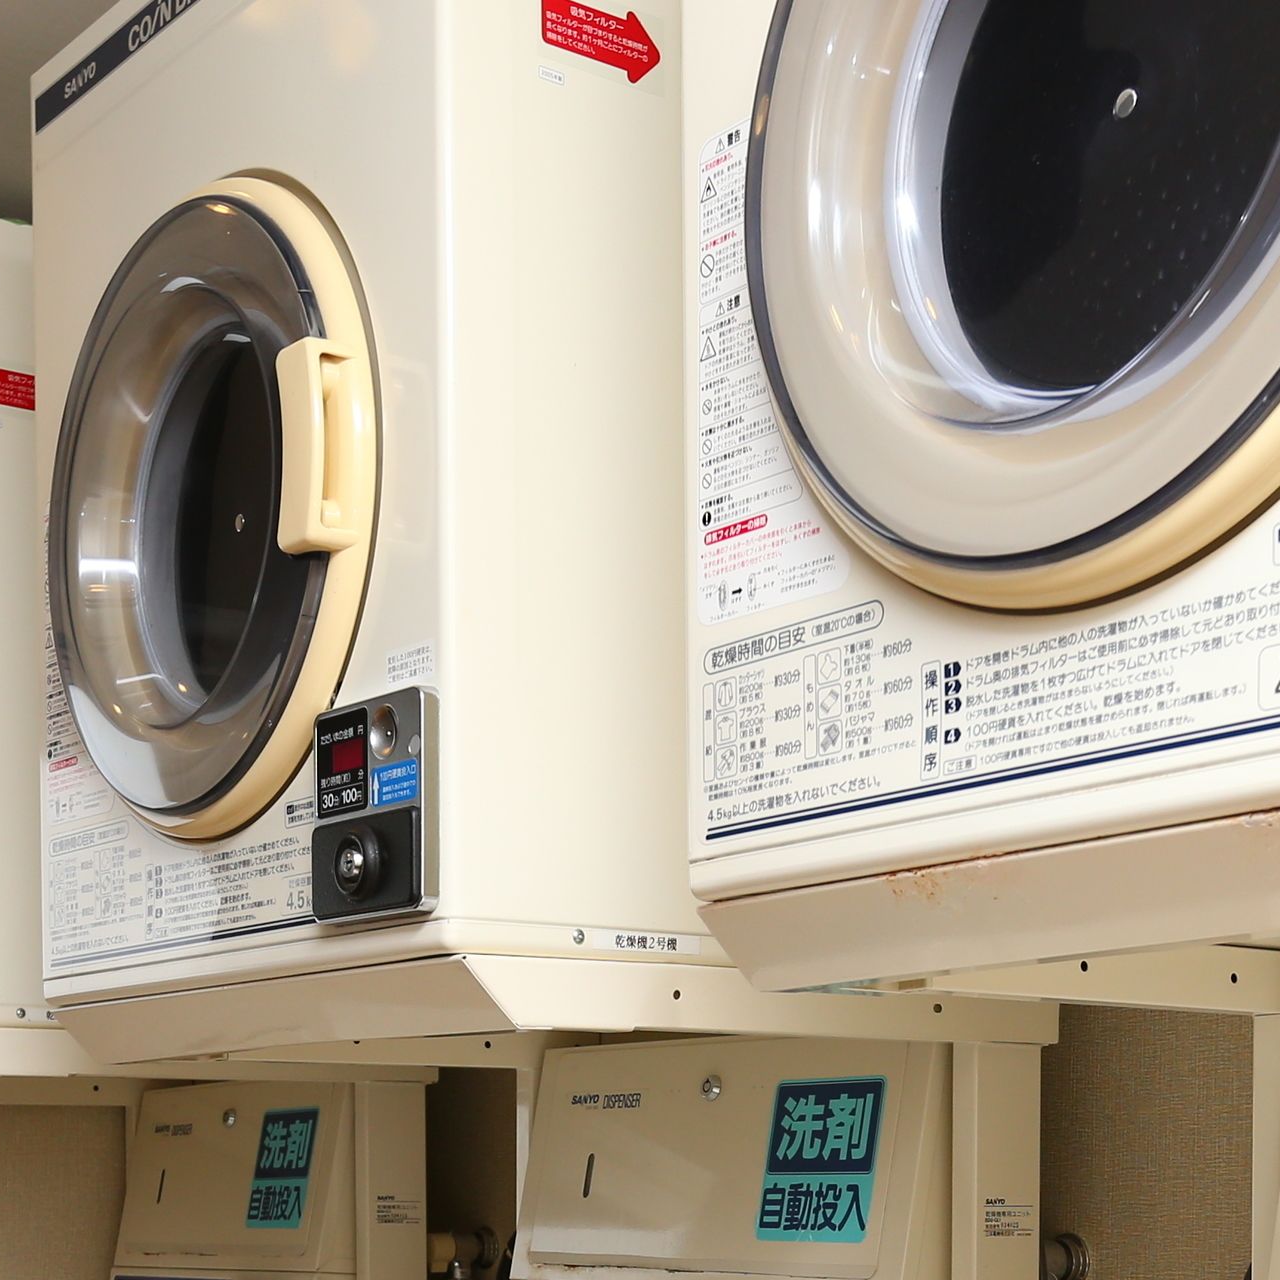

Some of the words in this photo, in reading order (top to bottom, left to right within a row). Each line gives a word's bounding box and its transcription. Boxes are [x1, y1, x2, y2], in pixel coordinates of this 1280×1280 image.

[570, 6, 624, 30] 吸気フィルター
[64, 62, 96, 98] SANYO
[727, 129, 741, 147] 警告
[726, 294, 741, 312] 注意
[711, 626, 806, 670] 乾燥時間の目安
[923, 670, 938, 773] 操作順序
[946, 758, 973, 773] ご注意
[286, 889, 312, 911] 4.5k
[615, 934, 677, 952] 乾燥機2号機
[571, 1094, 600, 1105] SANYO
[603, 1093, 642, 1109] DISPENSER
[776, 1093, 875, 1161] 洗剤
[260, 1119, 313, 1169] 洗剤
[246, 1185, 303, 1222] 自動投入
[759, 1182, 866, 1232] 自動投入
